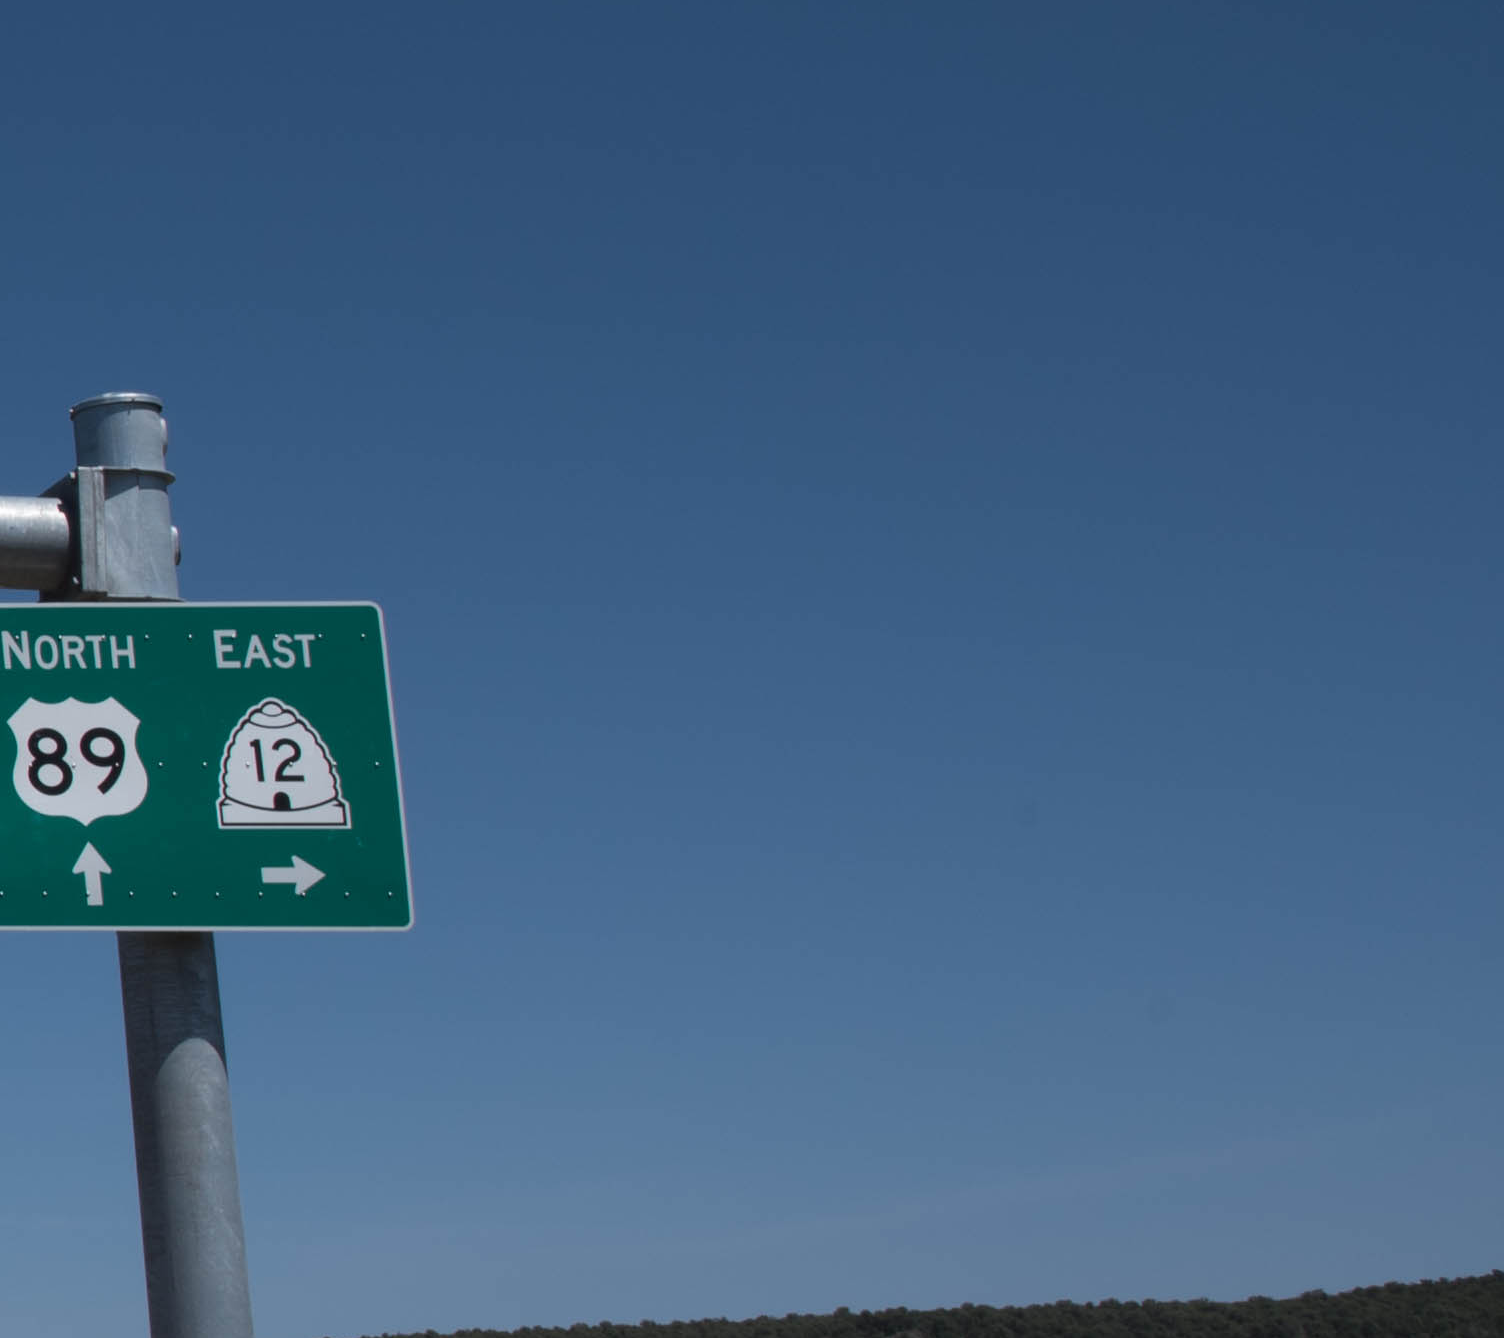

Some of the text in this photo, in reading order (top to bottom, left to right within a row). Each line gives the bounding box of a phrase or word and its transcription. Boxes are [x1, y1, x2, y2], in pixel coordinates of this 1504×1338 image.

[0, 630, 137, 670] NORTH
[212, 629, 316, 669] EAST
[27, 727, 126, 797] 89
[249, 738, 305, 783] 12
